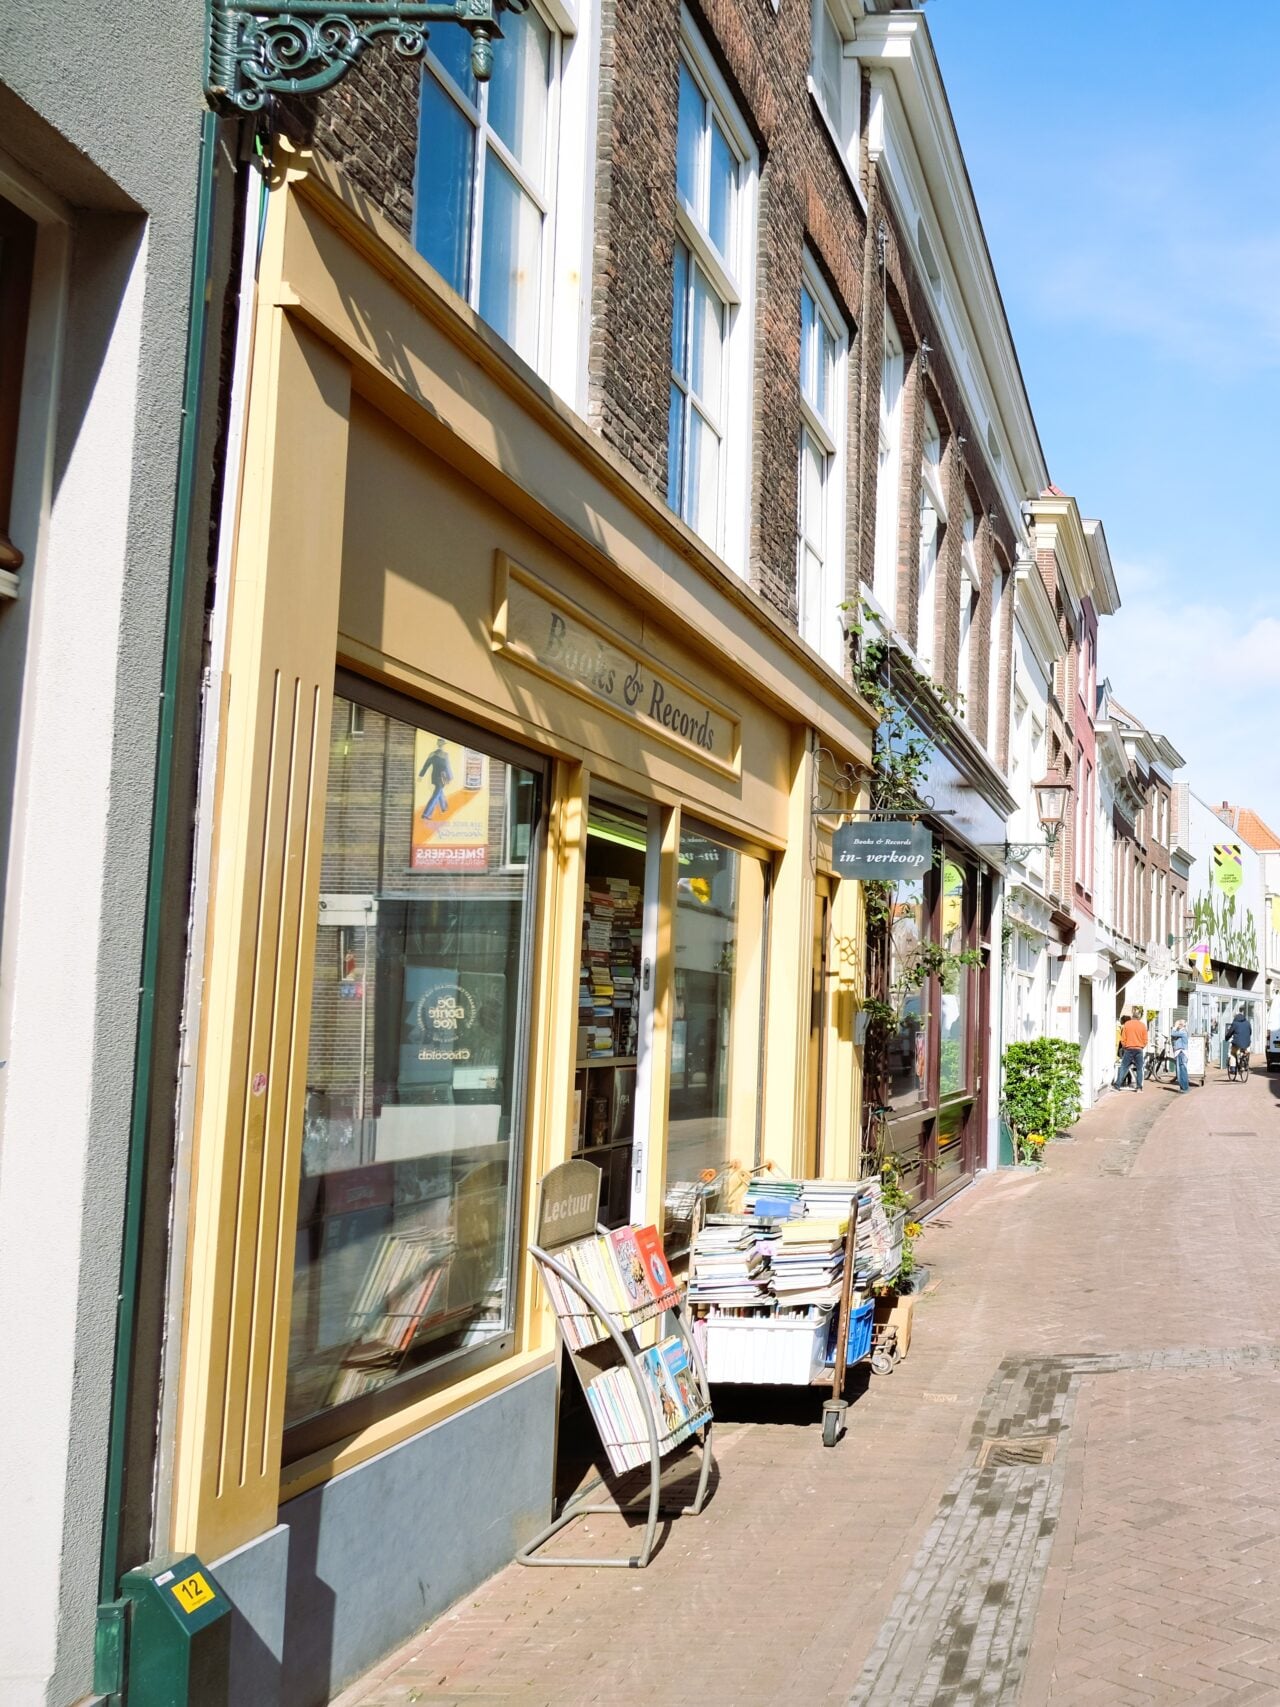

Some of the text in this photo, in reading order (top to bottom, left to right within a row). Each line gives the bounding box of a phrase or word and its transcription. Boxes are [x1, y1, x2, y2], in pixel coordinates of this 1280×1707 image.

[623, 661, 644, 706] &
[647, 680, 715, 751] Records
[840, 850, 925, 867] in- verkoop
[544, 1191, 593, 1224] Lectuur
[181, 1578, 203, 1600] 12
